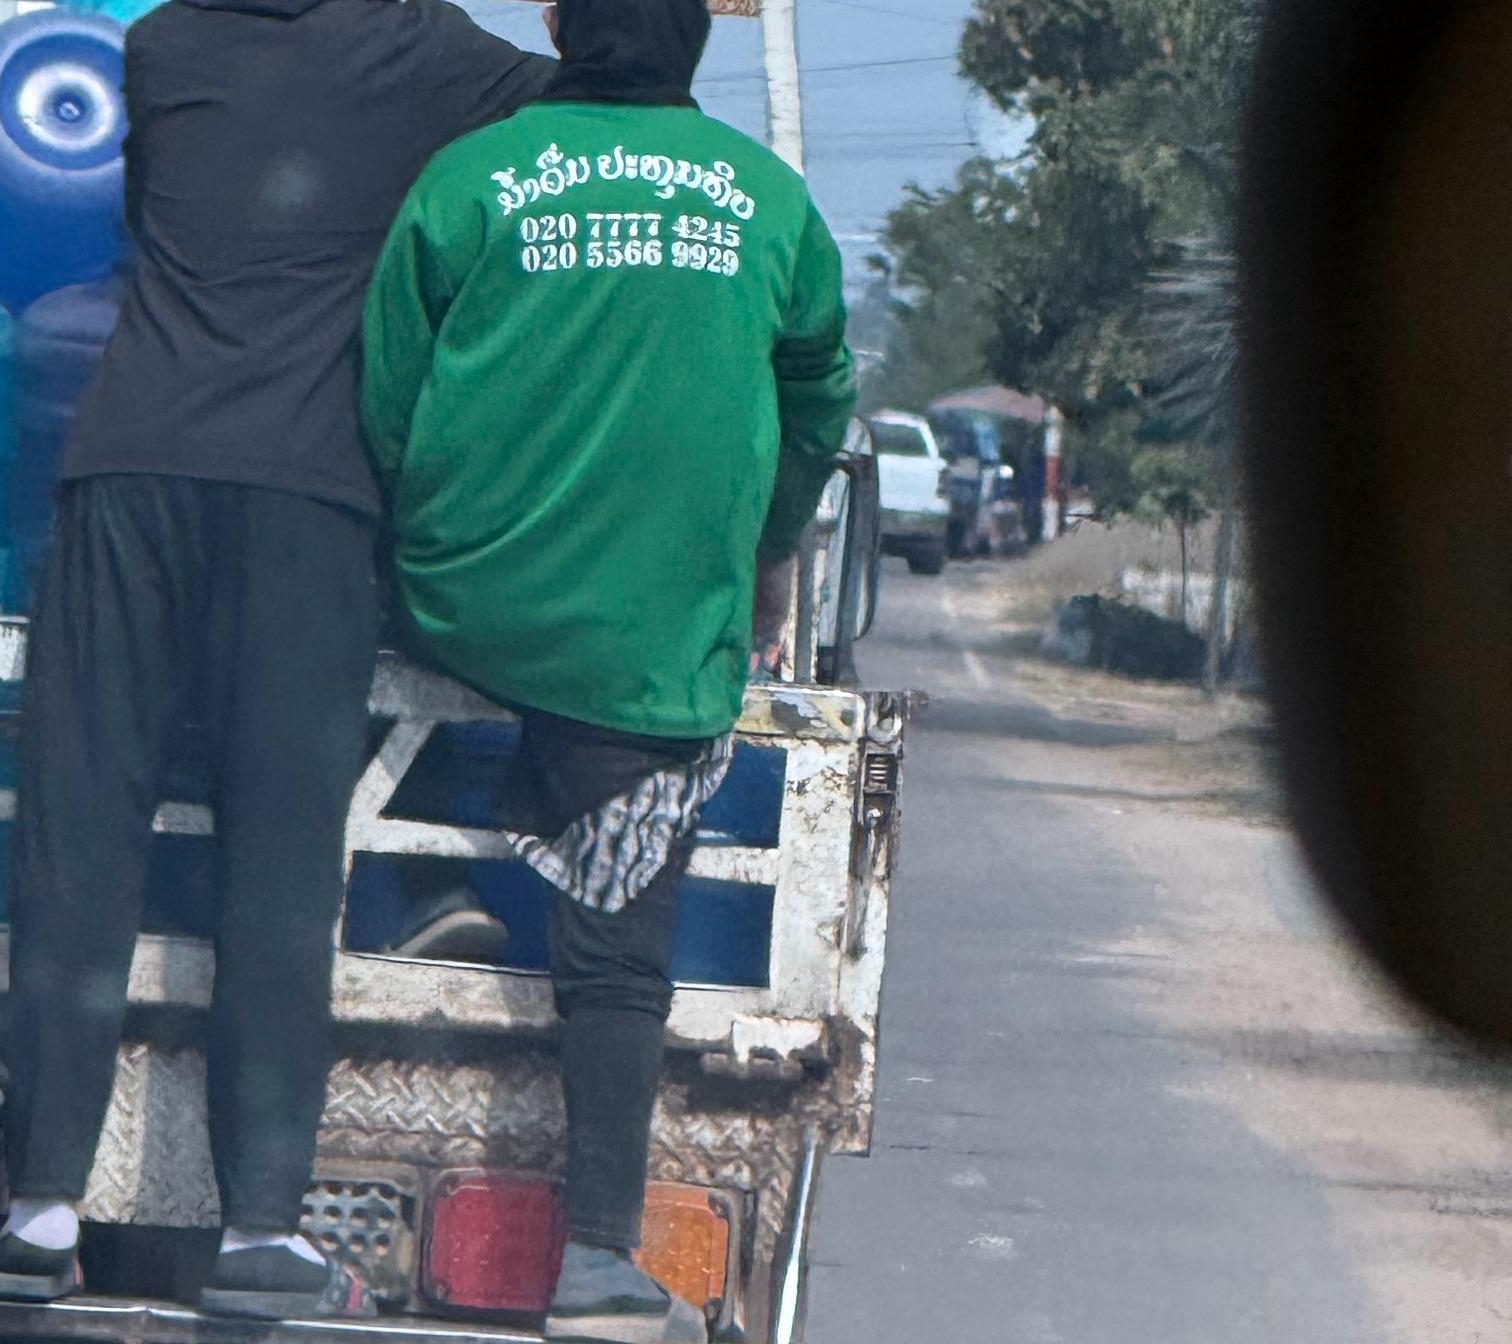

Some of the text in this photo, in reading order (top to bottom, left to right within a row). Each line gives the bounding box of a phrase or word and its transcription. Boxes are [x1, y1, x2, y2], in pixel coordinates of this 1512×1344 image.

[519, 212, 740, 248] 020 7777 4245
[521, 238, 739, 276] 020 5566 9929
